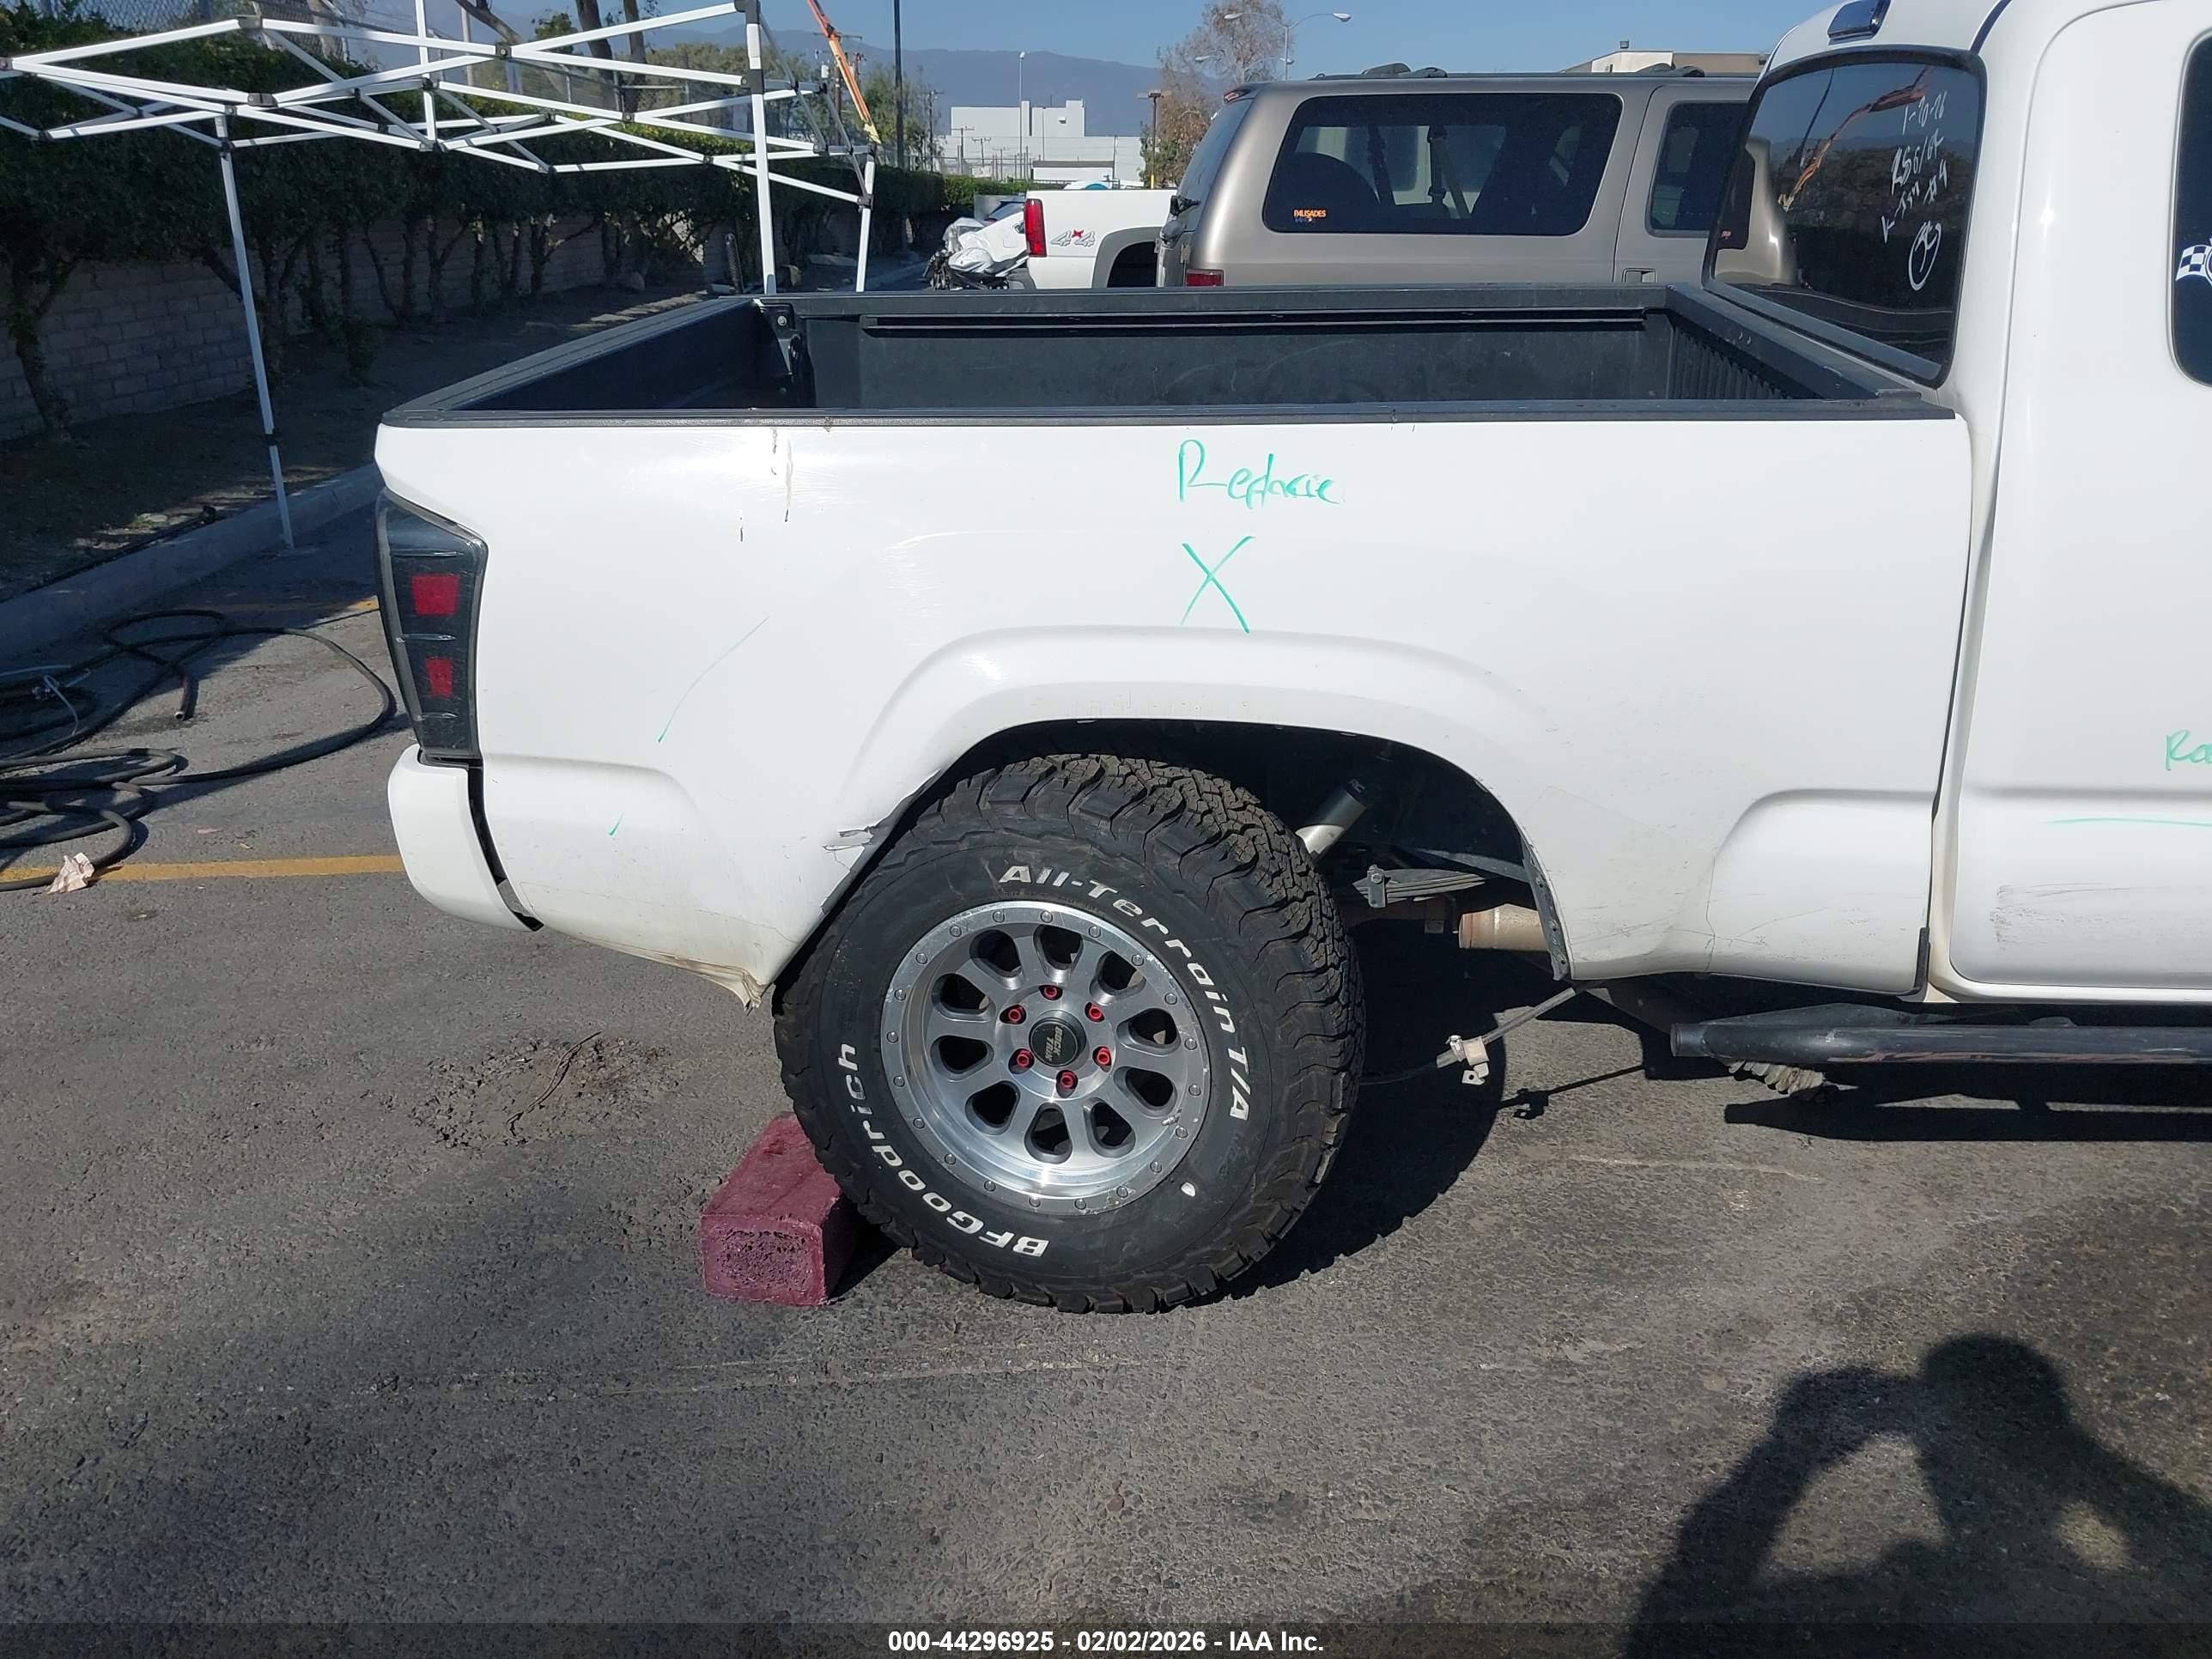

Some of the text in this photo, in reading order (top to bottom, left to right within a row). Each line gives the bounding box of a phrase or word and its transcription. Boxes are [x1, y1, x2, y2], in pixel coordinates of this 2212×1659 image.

[999, 865, 1236, 1033] All-Terrain
[1227, 1046, 1250, 1121] T/A
[838, 1043, 1049, 1257] BFGoodrich
